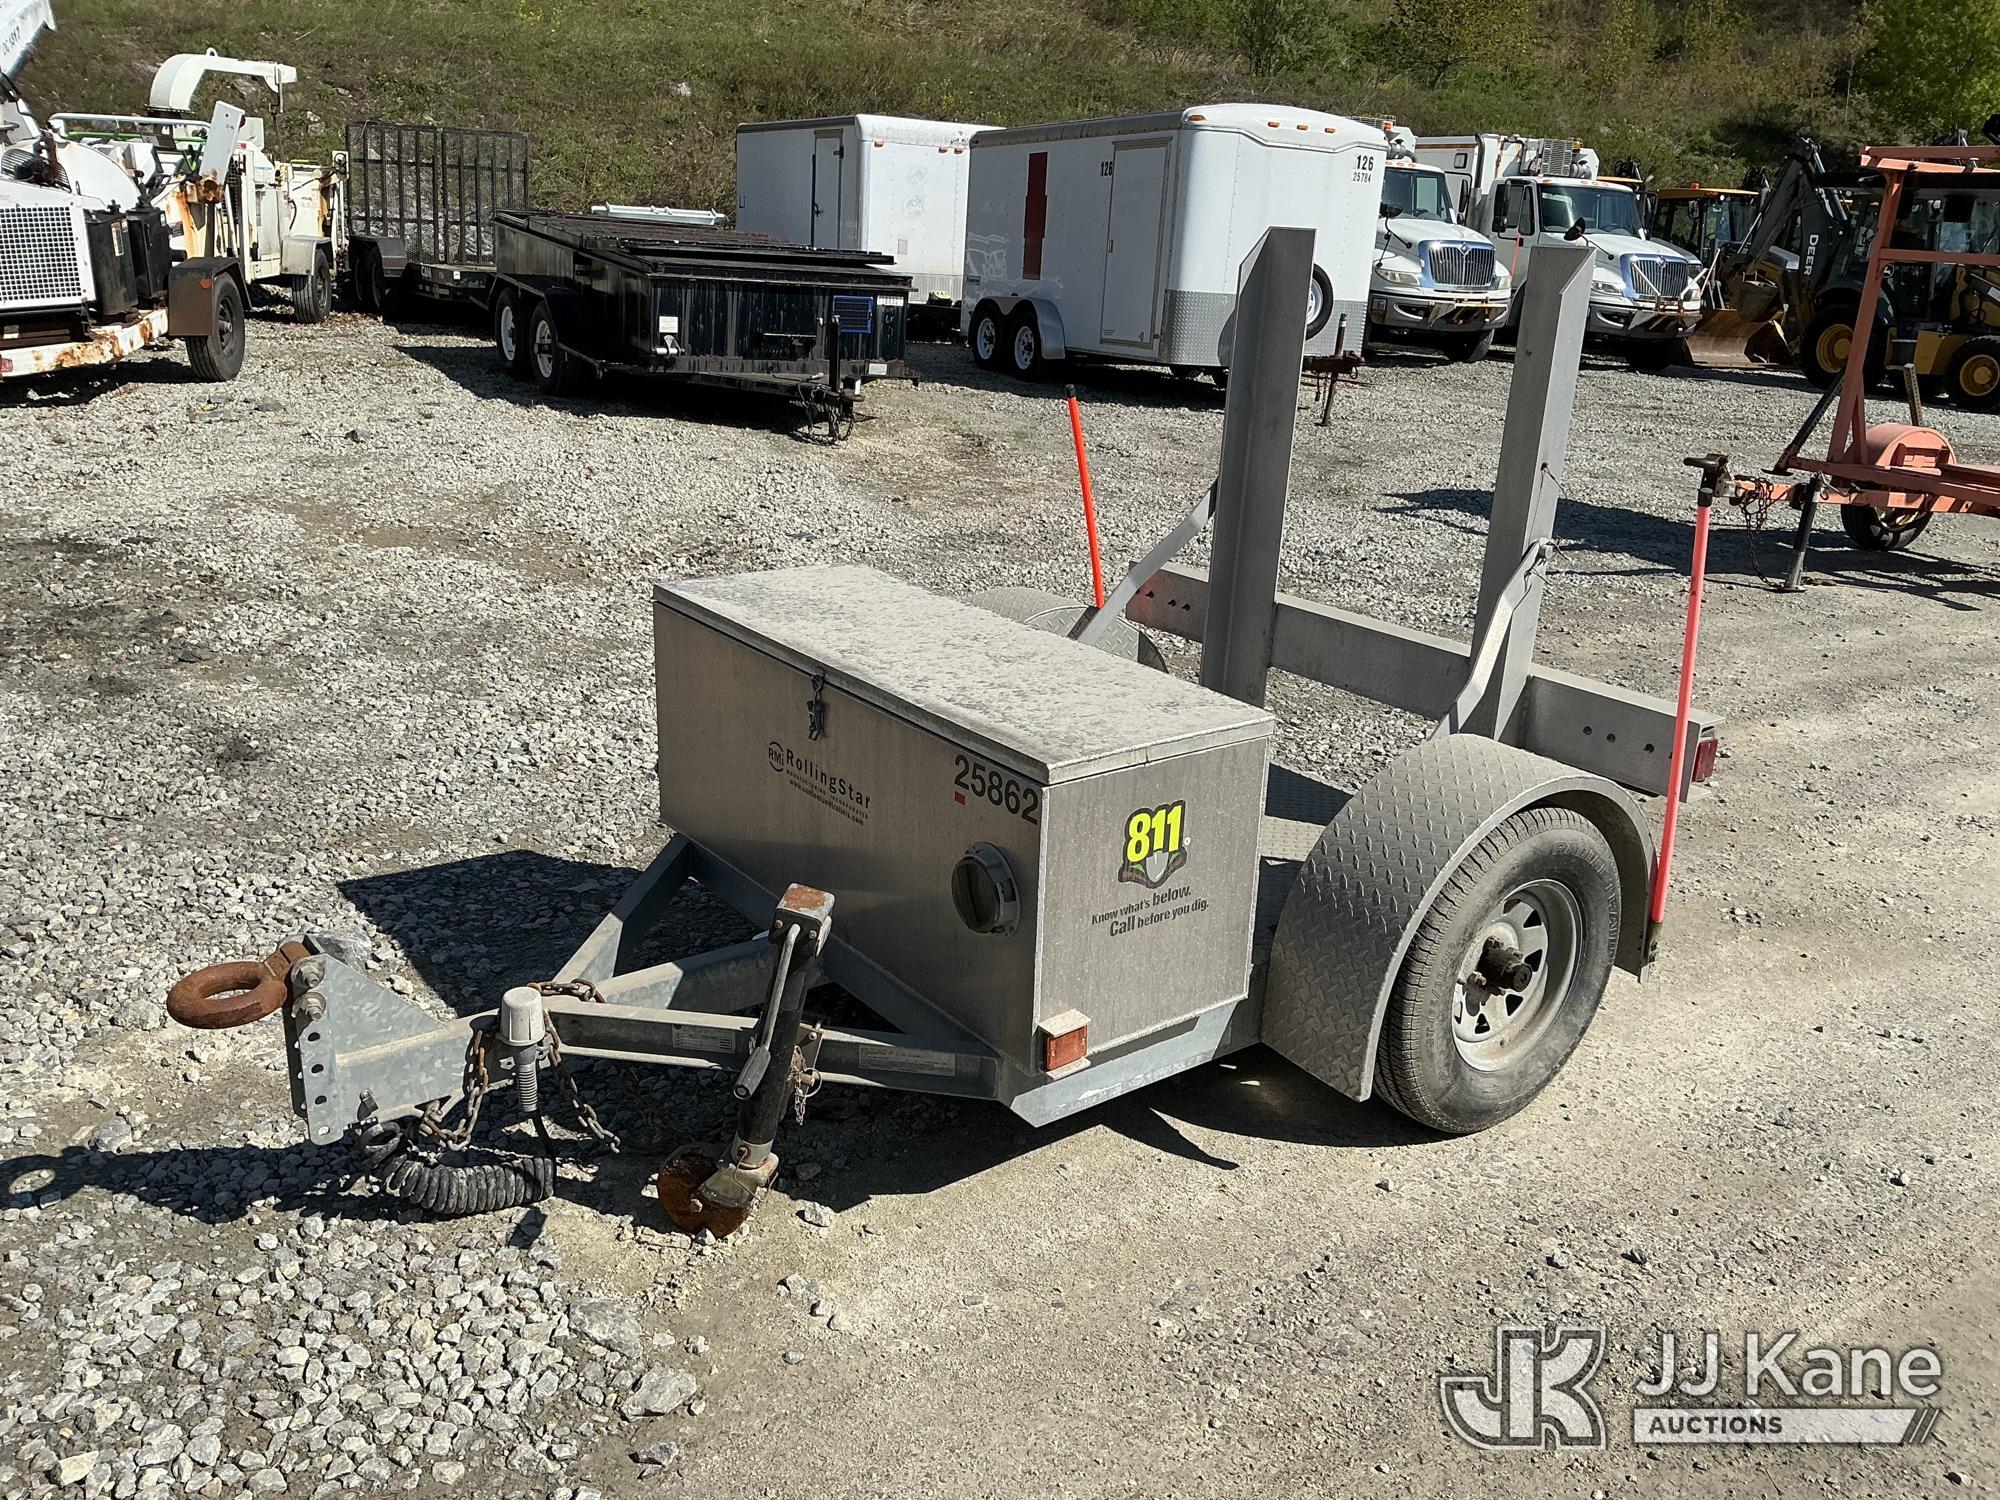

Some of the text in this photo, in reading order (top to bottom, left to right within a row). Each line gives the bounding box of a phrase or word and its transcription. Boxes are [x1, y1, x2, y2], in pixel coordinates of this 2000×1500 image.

[1100, 161, 1113, 177] 126
[1353, 171, 1372, 183] 25784
[1357, 154, 1374, 171] 126
[786, 748, 871, 809] RollingStar
[954, 754, 1039, 826] 25862
[1126, 804, 1183, 863] 811
[1091, 886, 1191, 925] Know what's below.
[1109, 898, 1209, 937] Call before you dig.
